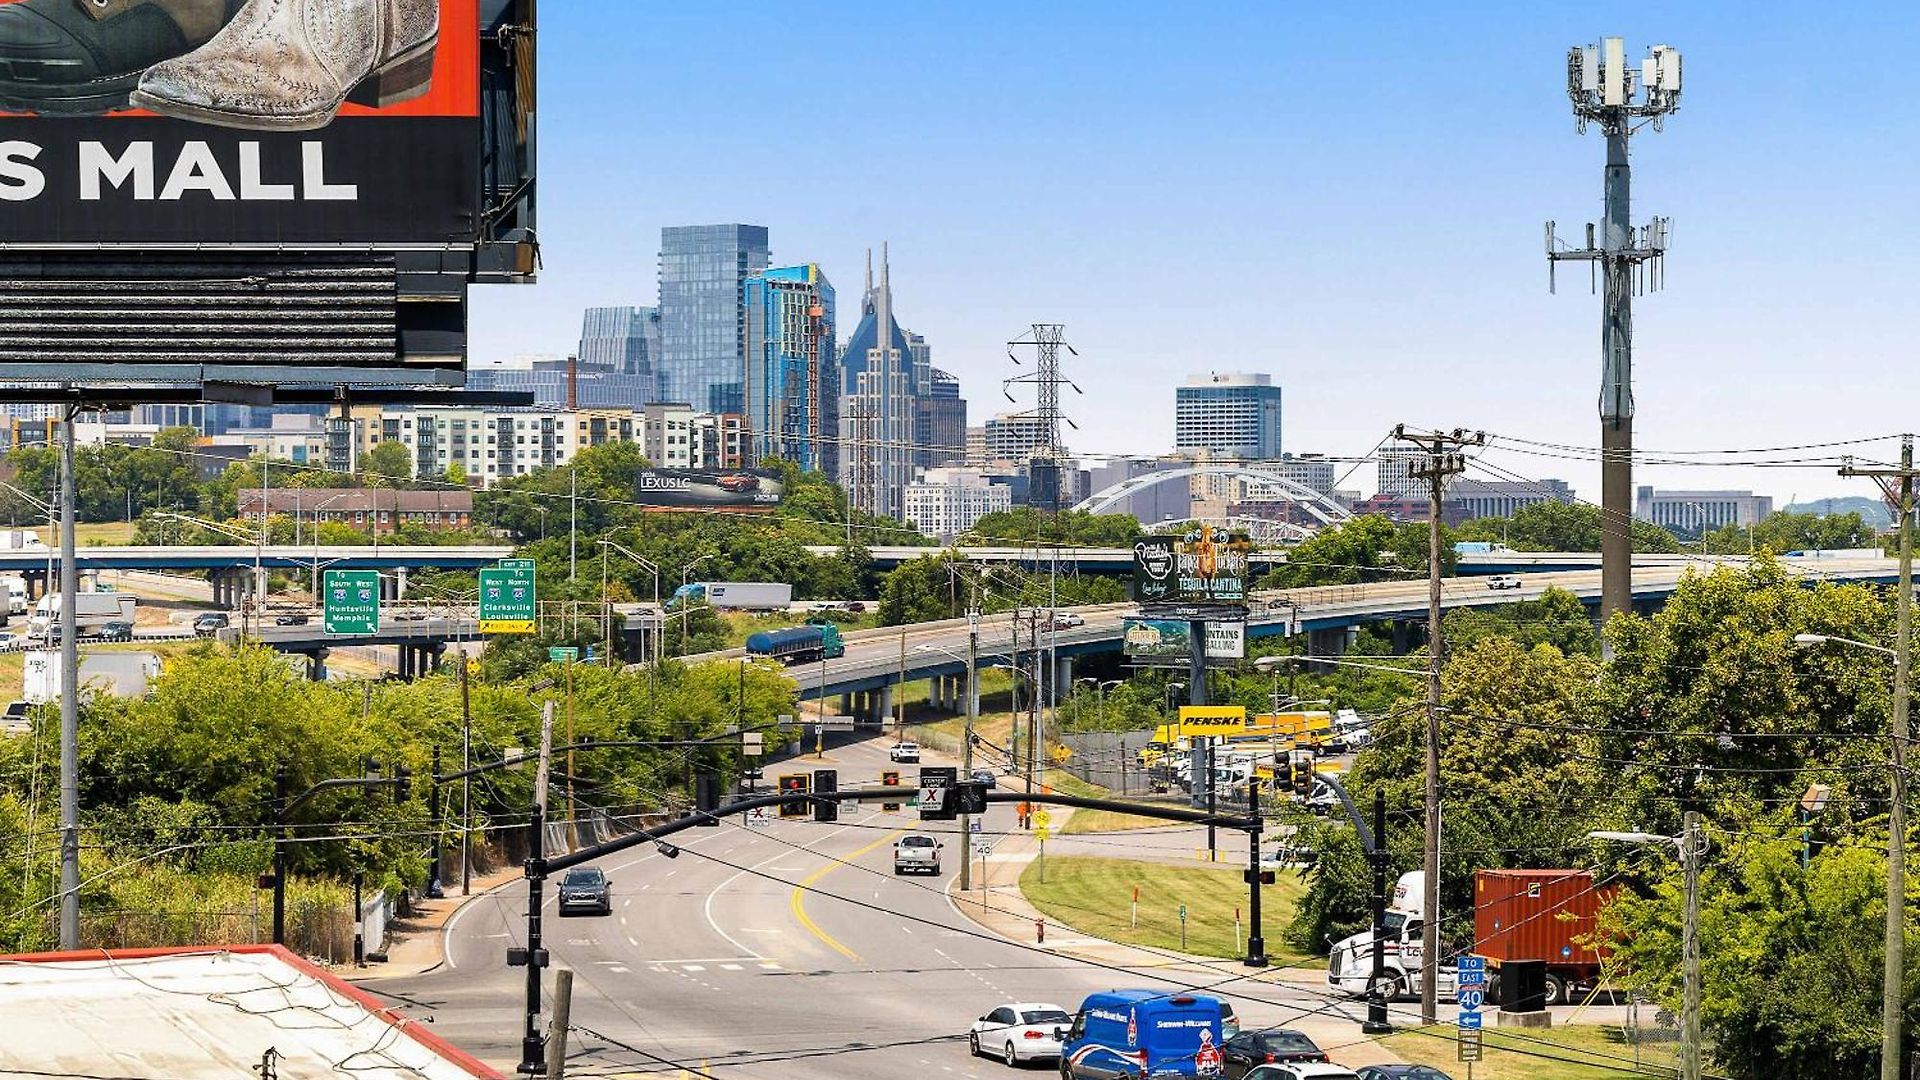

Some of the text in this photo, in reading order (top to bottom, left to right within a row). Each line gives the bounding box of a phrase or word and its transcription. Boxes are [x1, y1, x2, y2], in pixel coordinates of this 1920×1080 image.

[79, 141, 358, 200] MALL
[640, 478, 691, 488] LEXUS LC
[1179, 577, 1209, 592] TEQUILA
[1211, 577, 1242, 592] CANTINA
[483, 603, 531, 611] Clarksville
[332, 615, 371, 623] Memphis
[1183, 716, 1242, 726] PENSKE
[977, 846, 991, 854] 40
[1462, 974, 1479, 982] EAST
[1461, 991, 1481, 1005] 40
